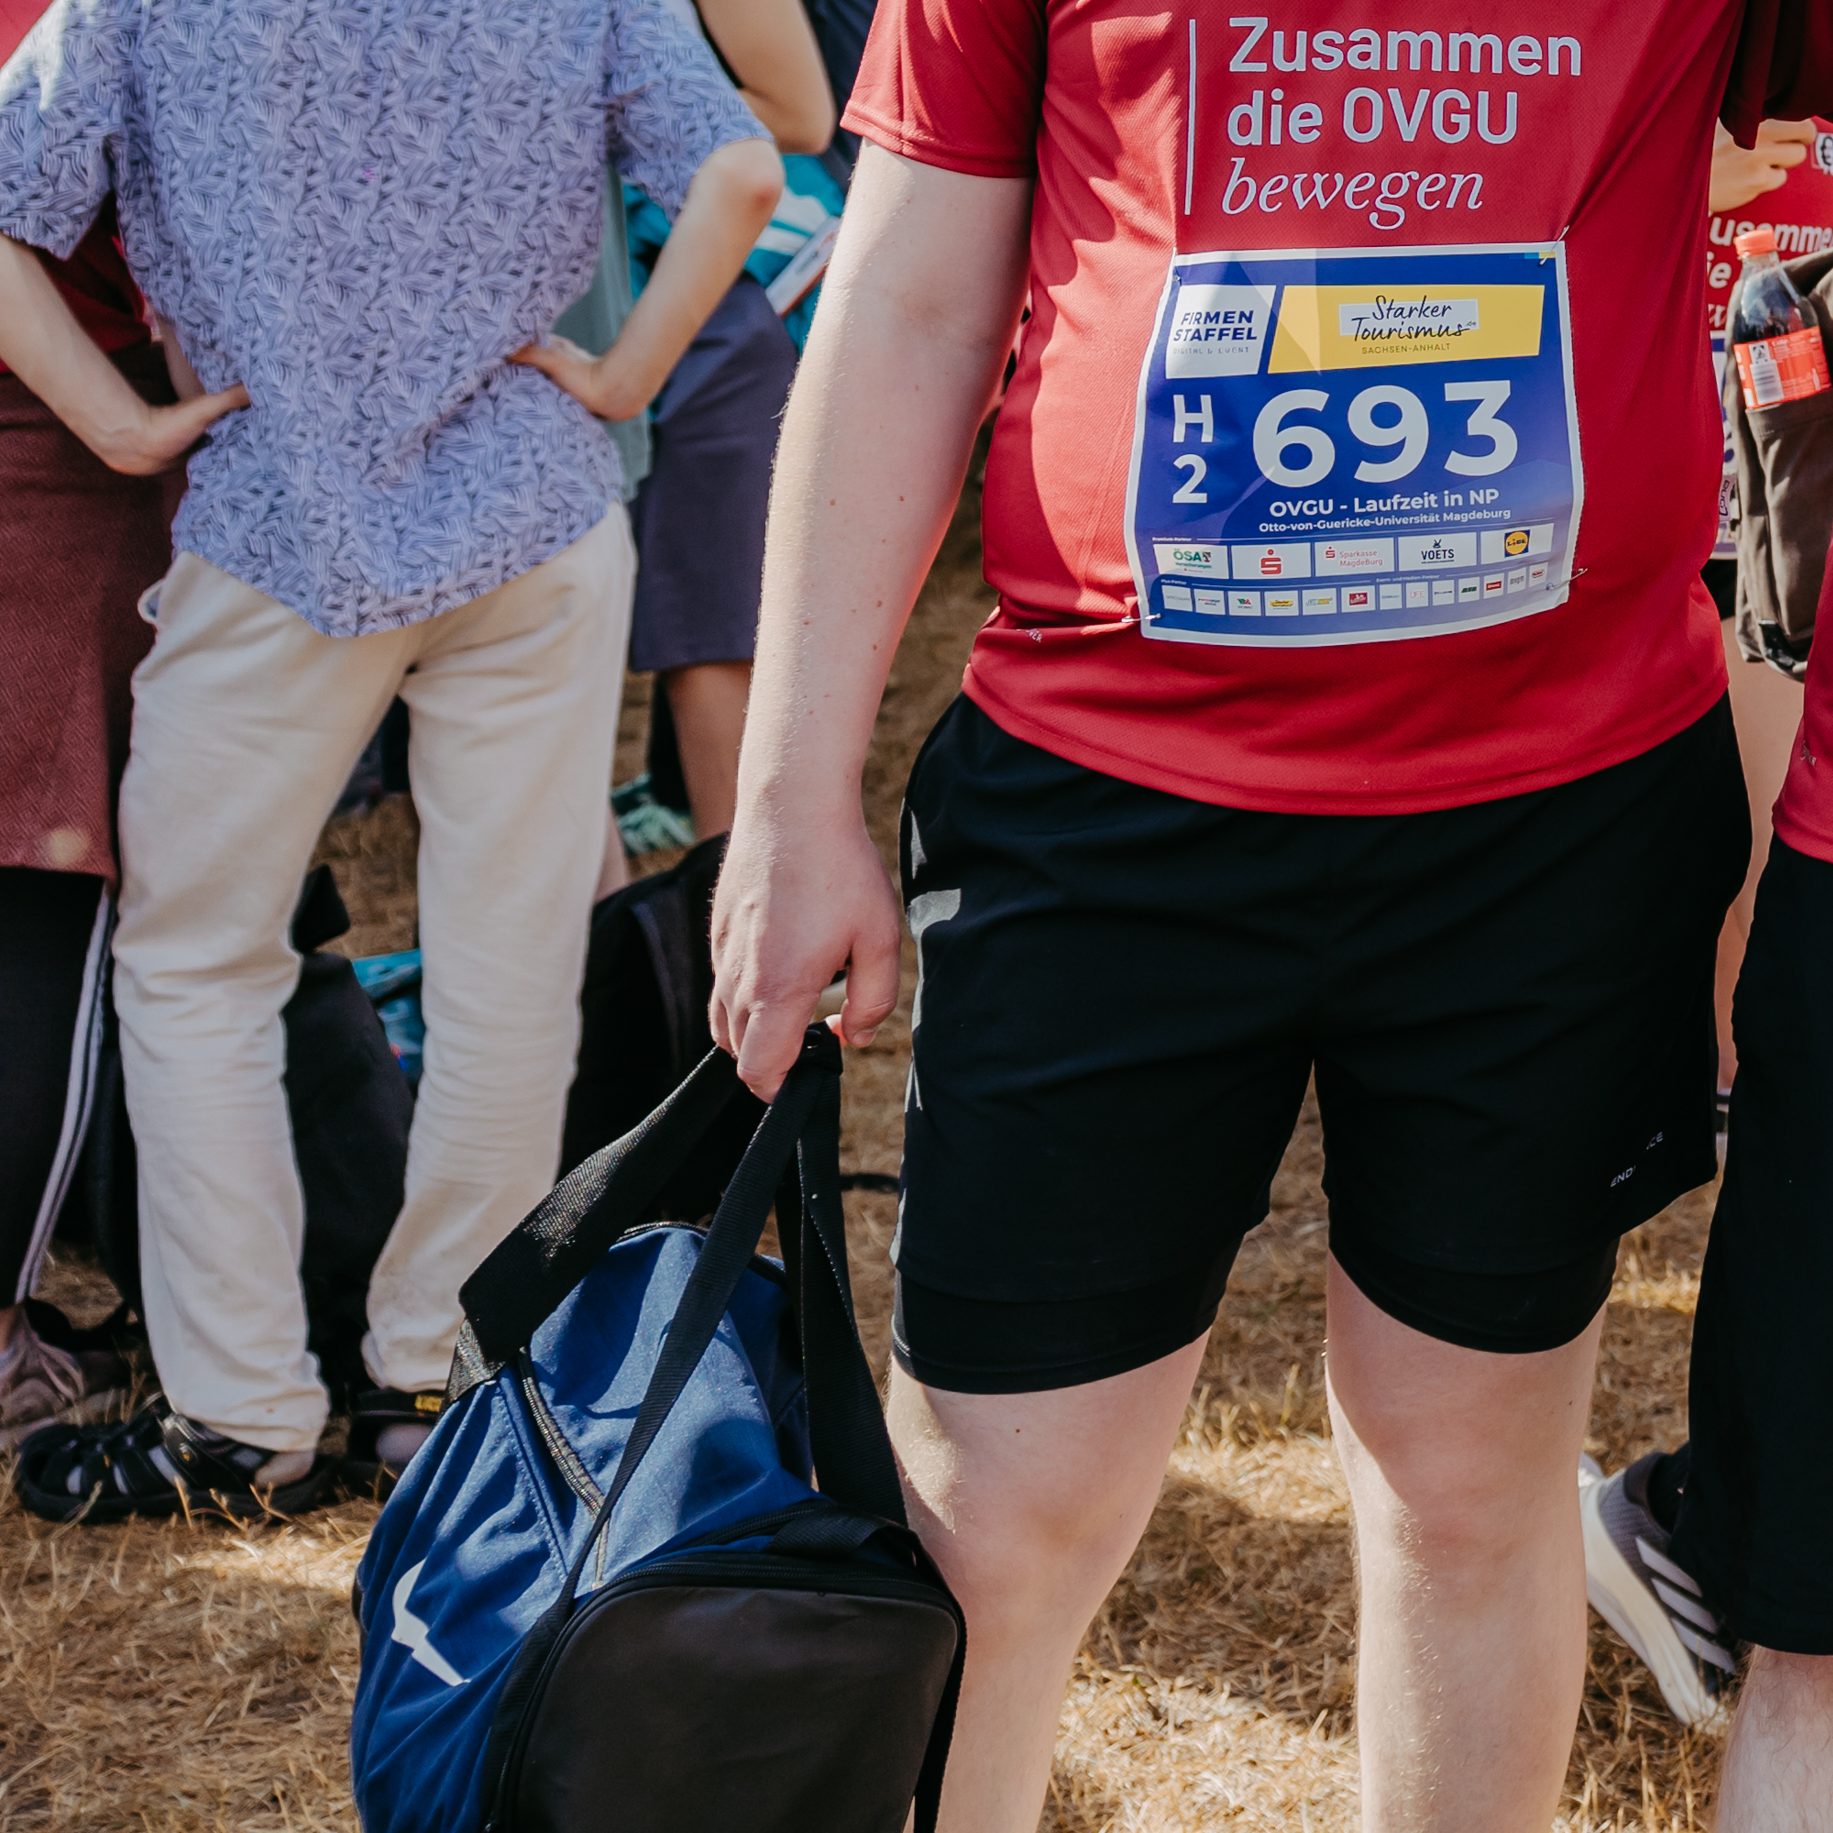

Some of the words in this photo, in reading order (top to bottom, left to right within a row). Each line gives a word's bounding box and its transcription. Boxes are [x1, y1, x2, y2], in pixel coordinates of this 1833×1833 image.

[1229, 16, 1582, 76] Zusammen
[1227, 88, 1323, 146] die
[1343, 86, 1518, 145] OVGU
[1221, 157, 1484, 230] bewegen
[1180, 310, 1255, 326] FIRMEN
[1371, 294, 1453, 321] Starker
[1172, 327, 1258, 342] STAFFEL
[1351, 317, 1471, 342] Tourismus
[1361, 342, 1451, 355] SACHSEN-ANHALT
[1172, 394, 1214, 443] H
[1253, 379, 1518, 488] 693
[1172, 453, 1208, 504] 2
[1269, 499, 1335, 518] OVGU
[1354, 491, 1438, 514] Laufzeit
[1443, 489, 1463, 507] in
[1469, 487, 1500, 505] NP
[1258, 512, 1440, 533] Otto-von-Guericke-Universität
[1443, 508, 1512, 523] Magdeburg
[1172, 548, 1202, 562] ÖSA
[1339, 549, 1378, 560] Sparkasse
[1421, 548, 1455, 561] VOETS
